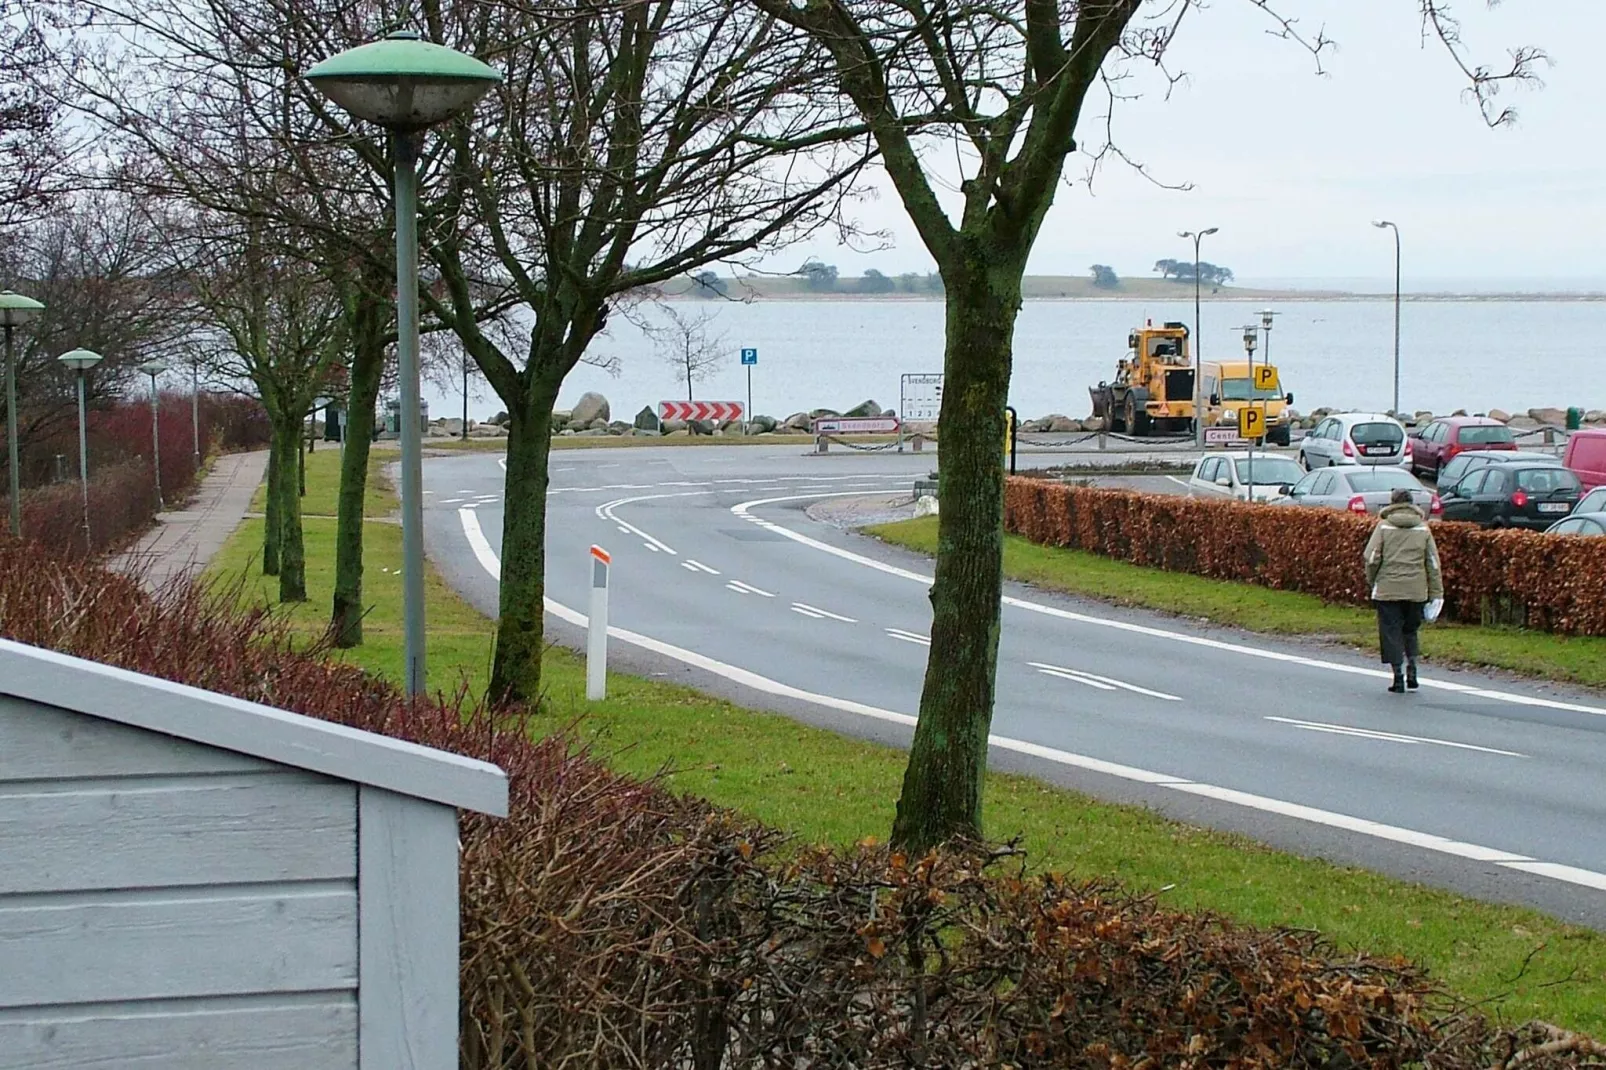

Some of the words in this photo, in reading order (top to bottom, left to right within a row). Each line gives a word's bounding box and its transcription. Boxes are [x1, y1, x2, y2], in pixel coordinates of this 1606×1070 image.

[745, 350, 754, 360] P
[1262, 369, 1272, 383] P
[1247, 411, 1258, 430] P
